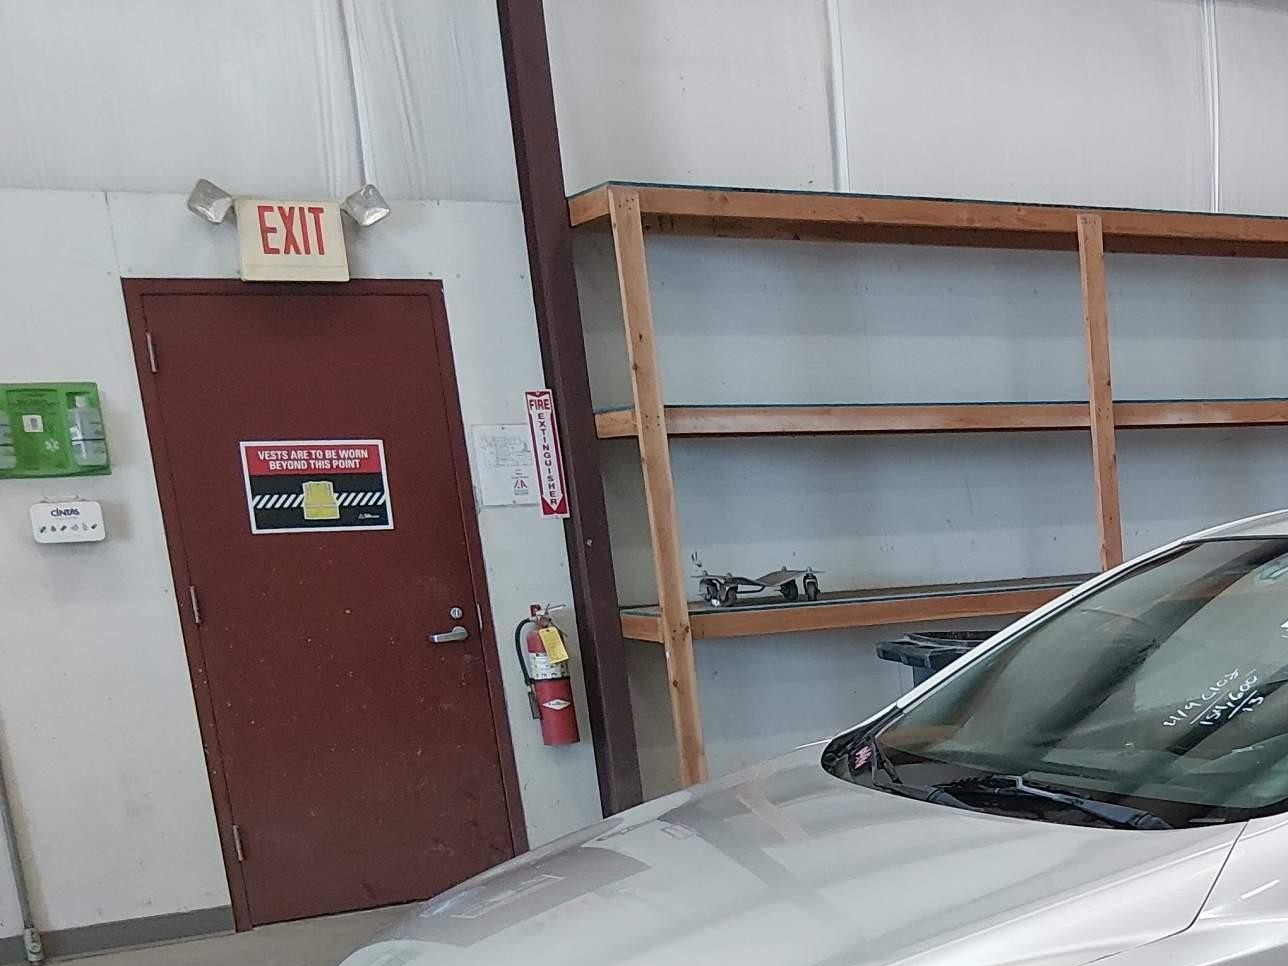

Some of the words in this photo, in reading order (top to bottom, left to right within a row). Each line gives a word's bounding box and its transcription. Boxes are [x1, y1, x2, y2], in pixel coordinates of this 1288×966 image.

[257, 205, 325, 255] EXIT
[528, 399, 551, 411] FIRE
[258, 450, 289, 460] VESTS
[290, 450, 309, 460] ARE
[311, 450, 323, 460] TO
[325, 450, 337, 459] BE
[338, 449, 368, 458] WORN
[537, 412, 558, 505] EXTINGUISHER
[269, 460, 308, 470] BEYOND
[309, 460, 331, 469] THIS
[333, 459, 361, 469] POINT
